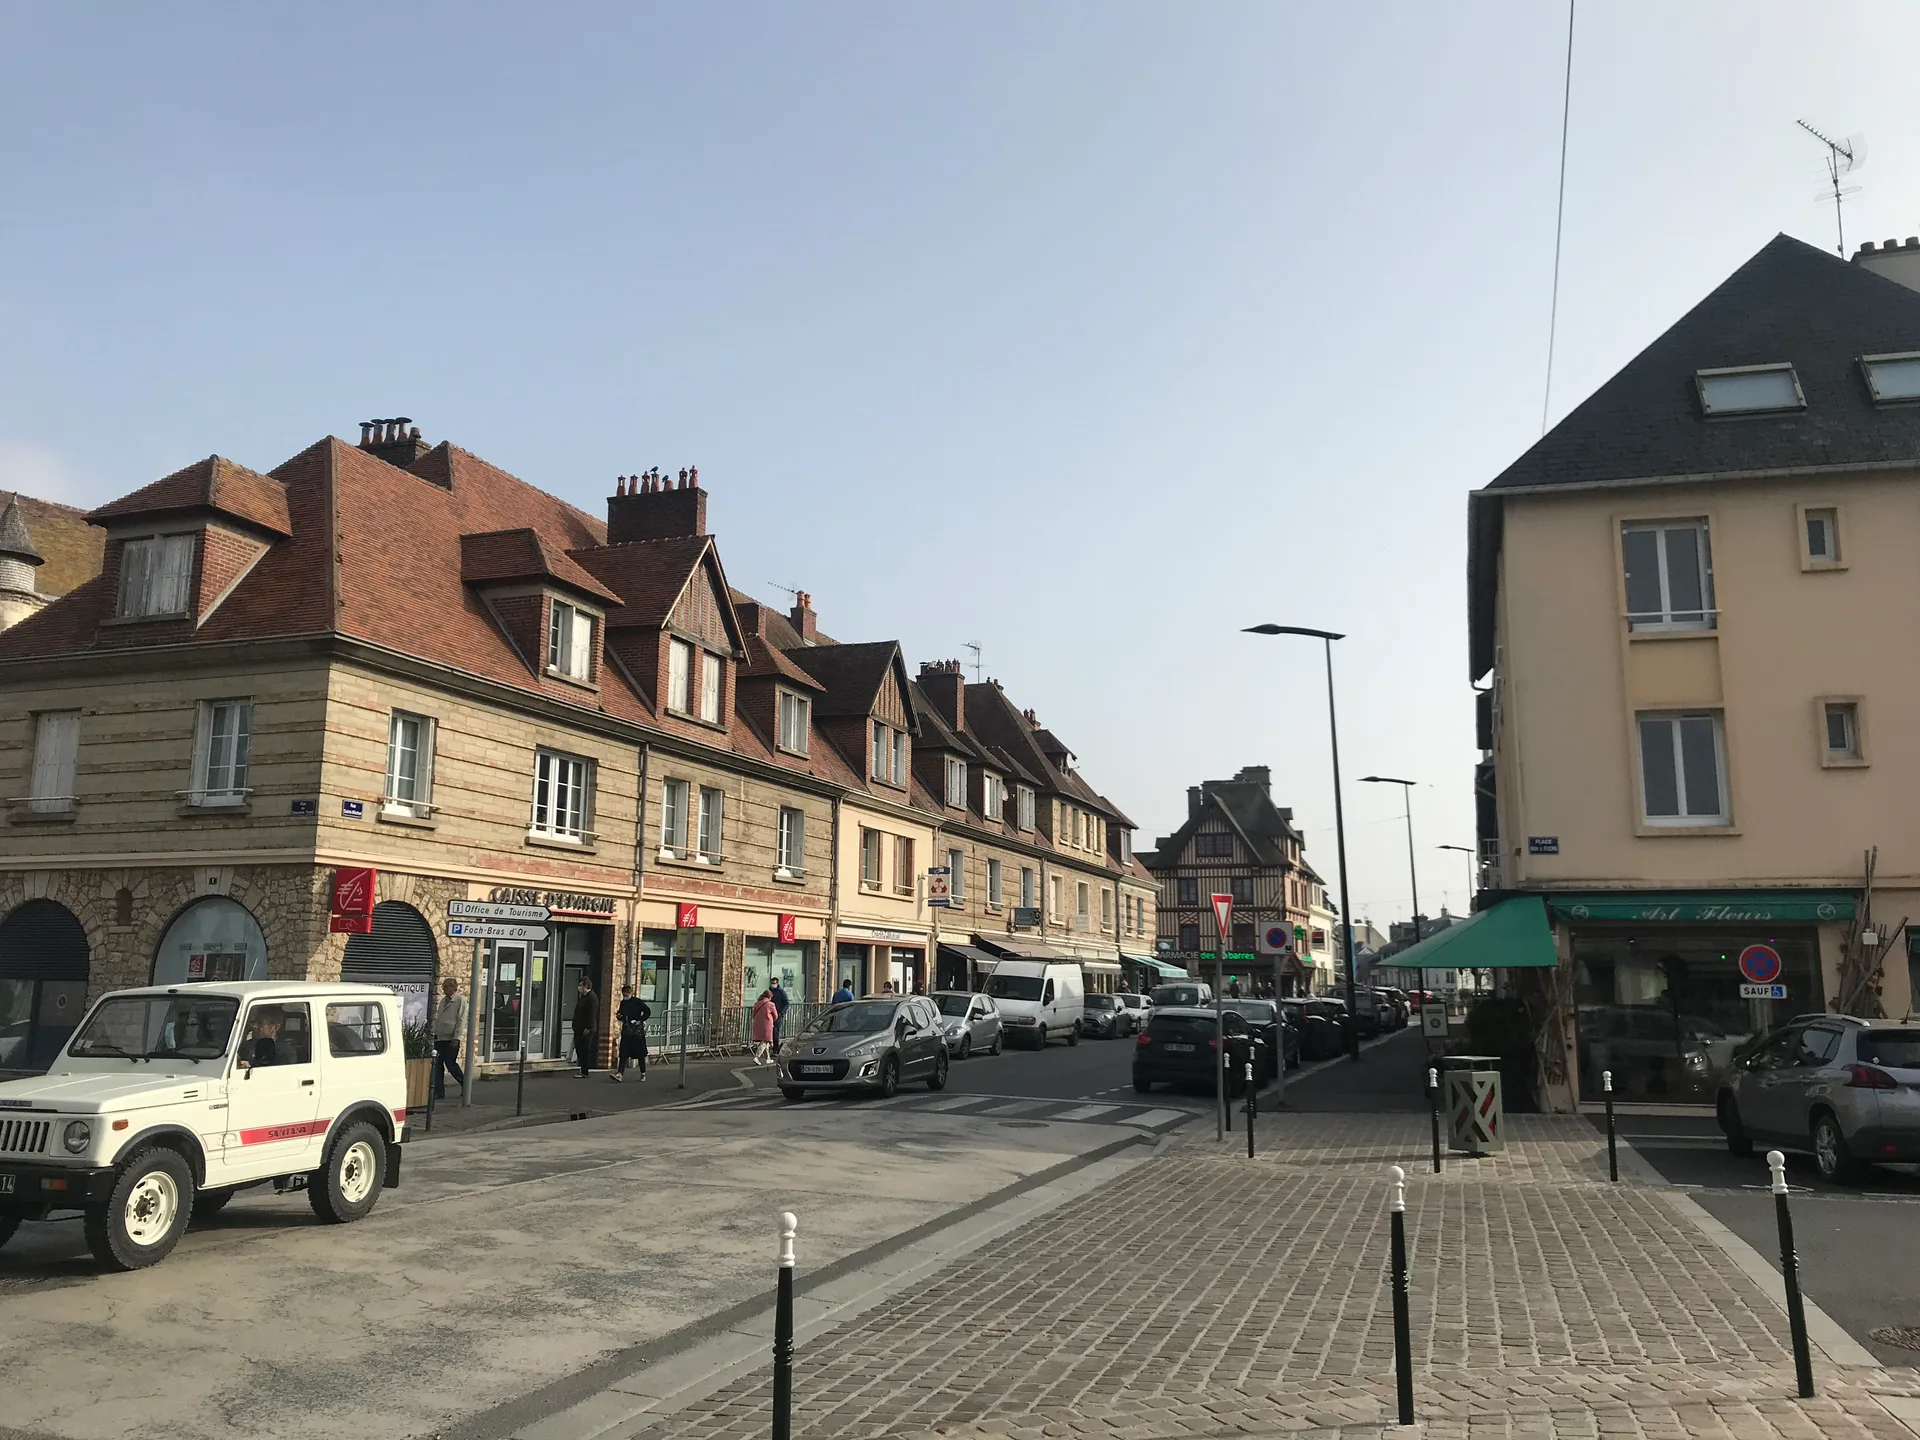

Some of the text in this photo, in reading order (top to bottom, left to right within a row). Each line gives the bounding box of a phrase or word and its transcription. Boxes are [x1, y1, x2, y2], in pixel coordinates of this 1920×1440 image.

[489, 887, 542, 904] CAISSE
[465, 904, 490, 914] Office
[494, 905, 504, 915] de
[509, 907, 544, 918] Tourisme
[1636, 906, 1774, 921] Art Fleurs
[463, 926, 505, 936] Foch-Bras
[509, 928, 528, 937] d'Or
[1200, 951, 1216, 960] des
[1743, 985, 1770, 996] SAUF
[267, 1126, 307, 1138] SANTANA
